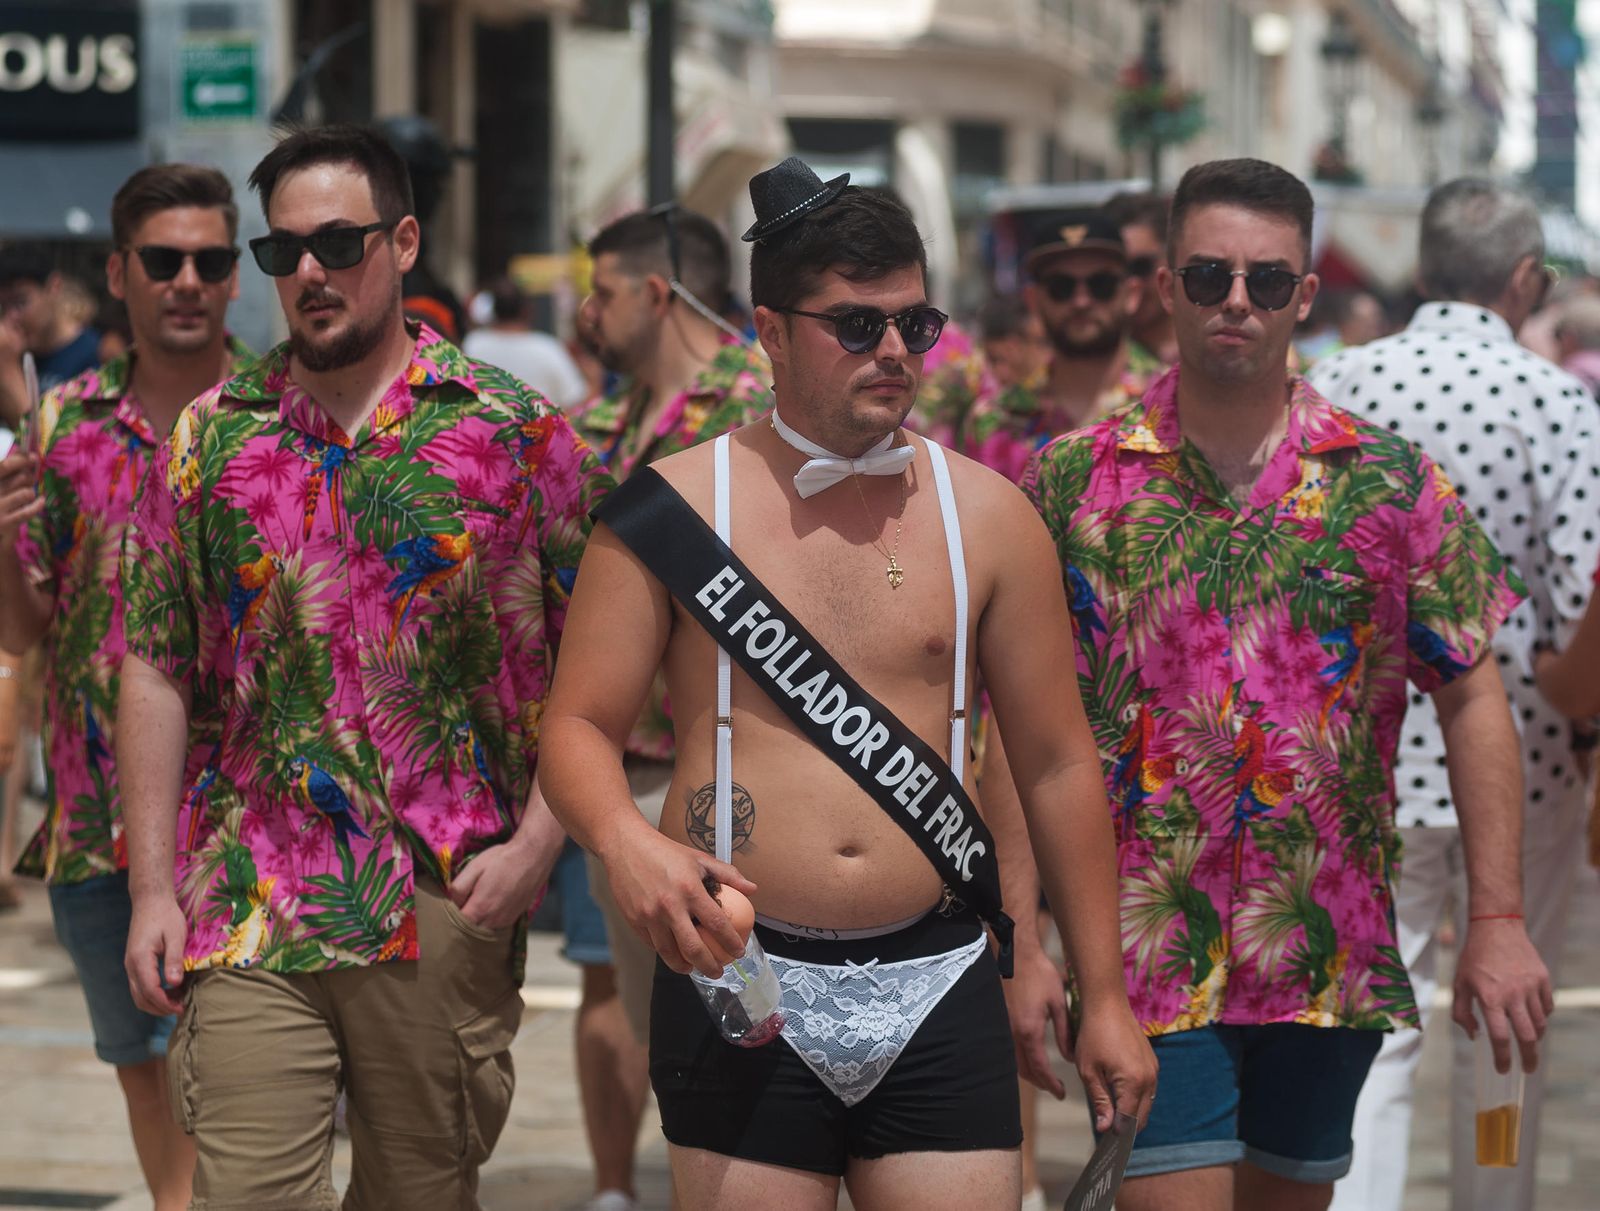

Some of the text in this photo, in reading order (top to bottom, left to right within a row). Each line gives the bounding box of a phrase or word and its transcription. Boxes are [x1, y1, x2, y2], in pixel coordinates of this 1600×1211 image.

[695, 565, 986, 882] EL FOLLADOR DEL FRAC
